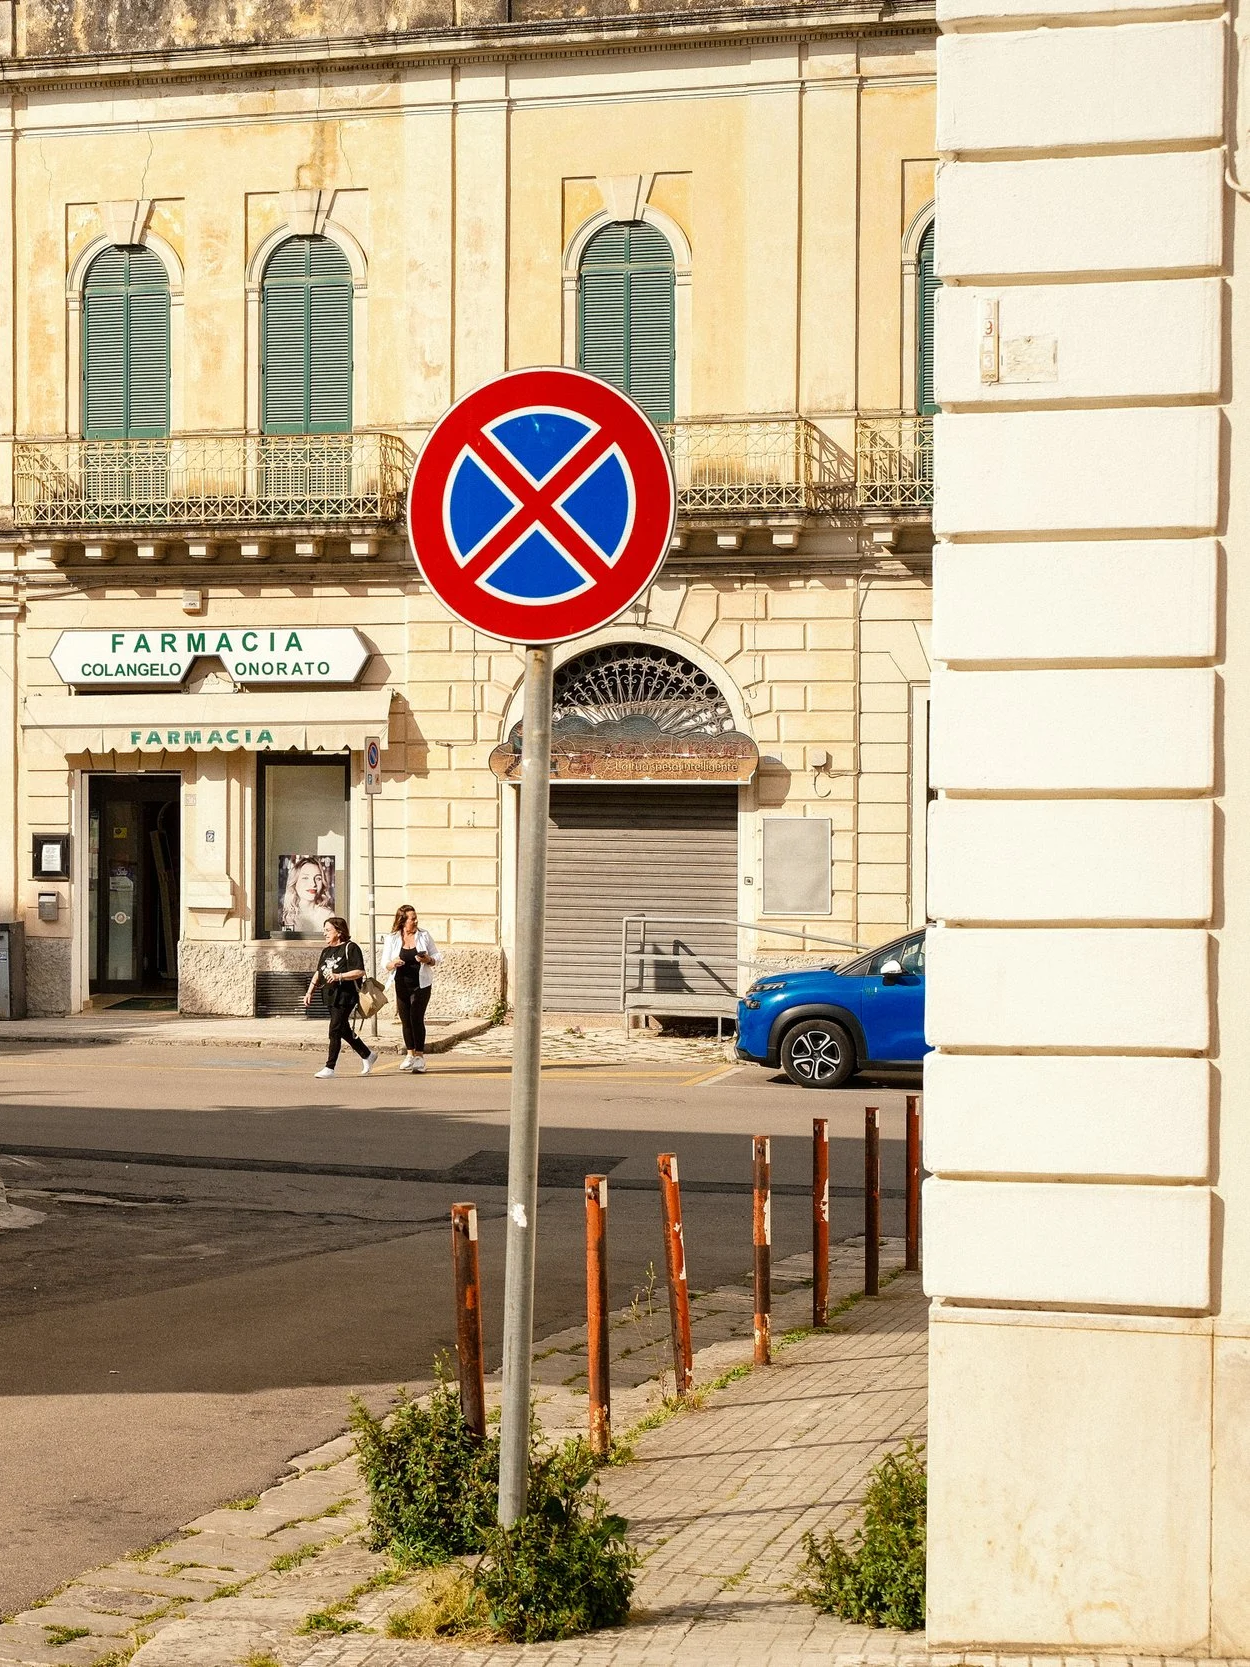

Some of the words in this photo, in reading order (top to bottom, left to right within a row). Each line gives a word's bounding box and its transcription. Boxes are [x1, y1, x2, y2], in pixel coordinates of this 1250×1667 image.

[111, 631, 303, 653] FARMACIA
[81, 662, 182, 677] COLANGELO
[234, 661, 331, 676] ONORATO
[130, 729, 274, 745] FARMACIA
[615, 761, 627, 771] La
[679, 761, 739, 774] intelligente
